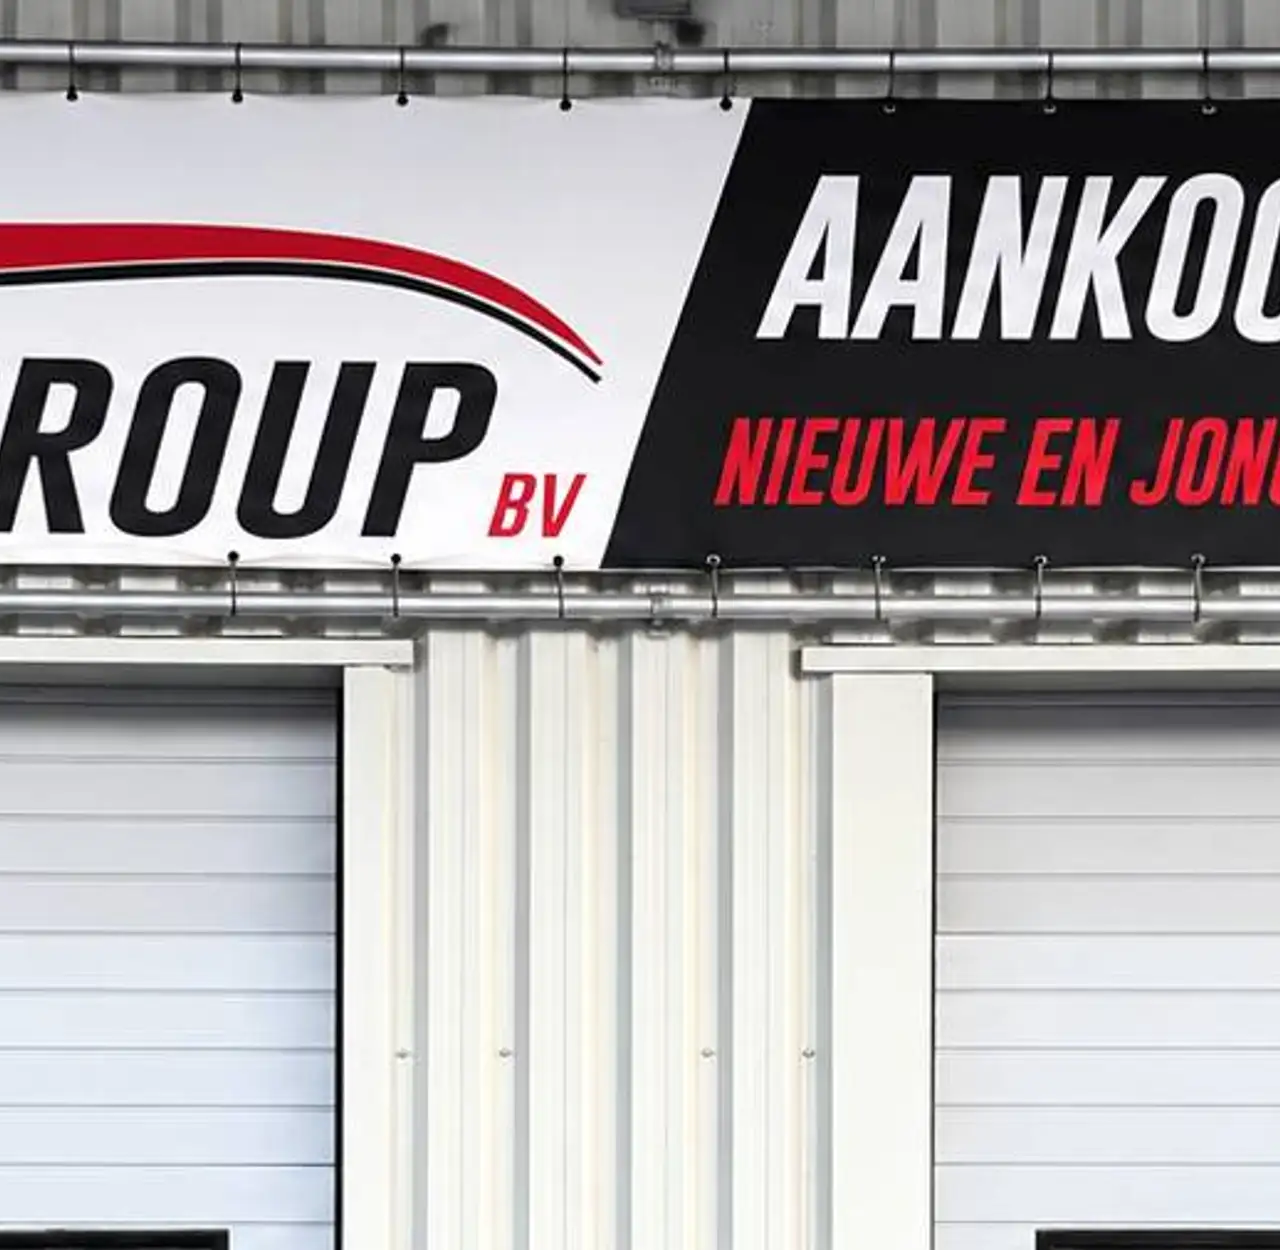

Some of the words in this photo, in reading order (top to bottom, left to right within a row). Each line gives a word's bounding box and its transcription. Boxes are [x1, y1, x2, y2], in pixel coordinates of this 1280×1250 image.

[713, 416, 1007, 507] NIEUWE
[1016, 415, 1121, 508] EN
[487, 472, 587, 539] BV
